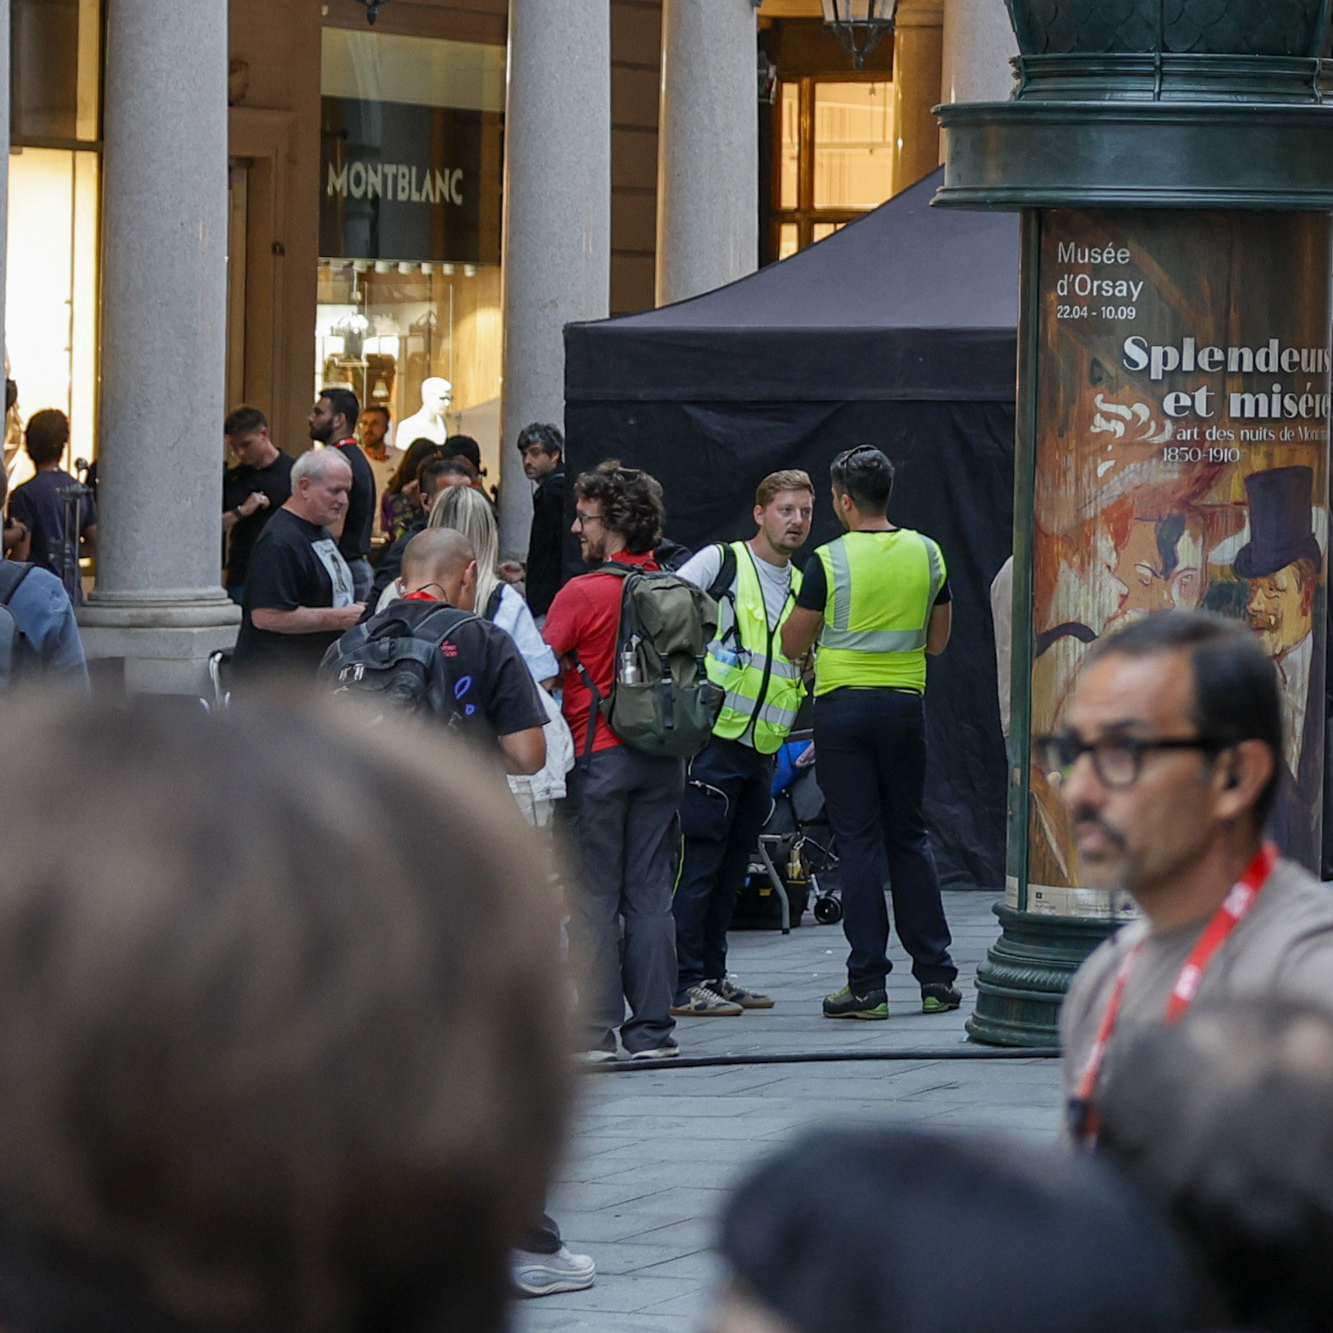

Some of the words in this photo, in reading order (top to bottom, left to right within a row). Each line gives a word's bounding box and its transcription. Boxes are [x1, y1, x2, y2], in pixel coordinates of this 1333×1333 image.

[327, 161, 464, 206] MONTBLANC
[1058, 241, 1131, 264] Musée
[1056, 273, 1144, 302] d'Orsay
[1057, 305, 1088, 319] 22.04
[1100, 306, 1136, 320] 10.09
[1162, 385, 1215, 417] et
[1205, 425, 1235, 441] des
[1240, 426, 1275, 441] nuits
[1279, 426, 1295, 441] de
[1163, 447, 1241, 463] 1850-1910
